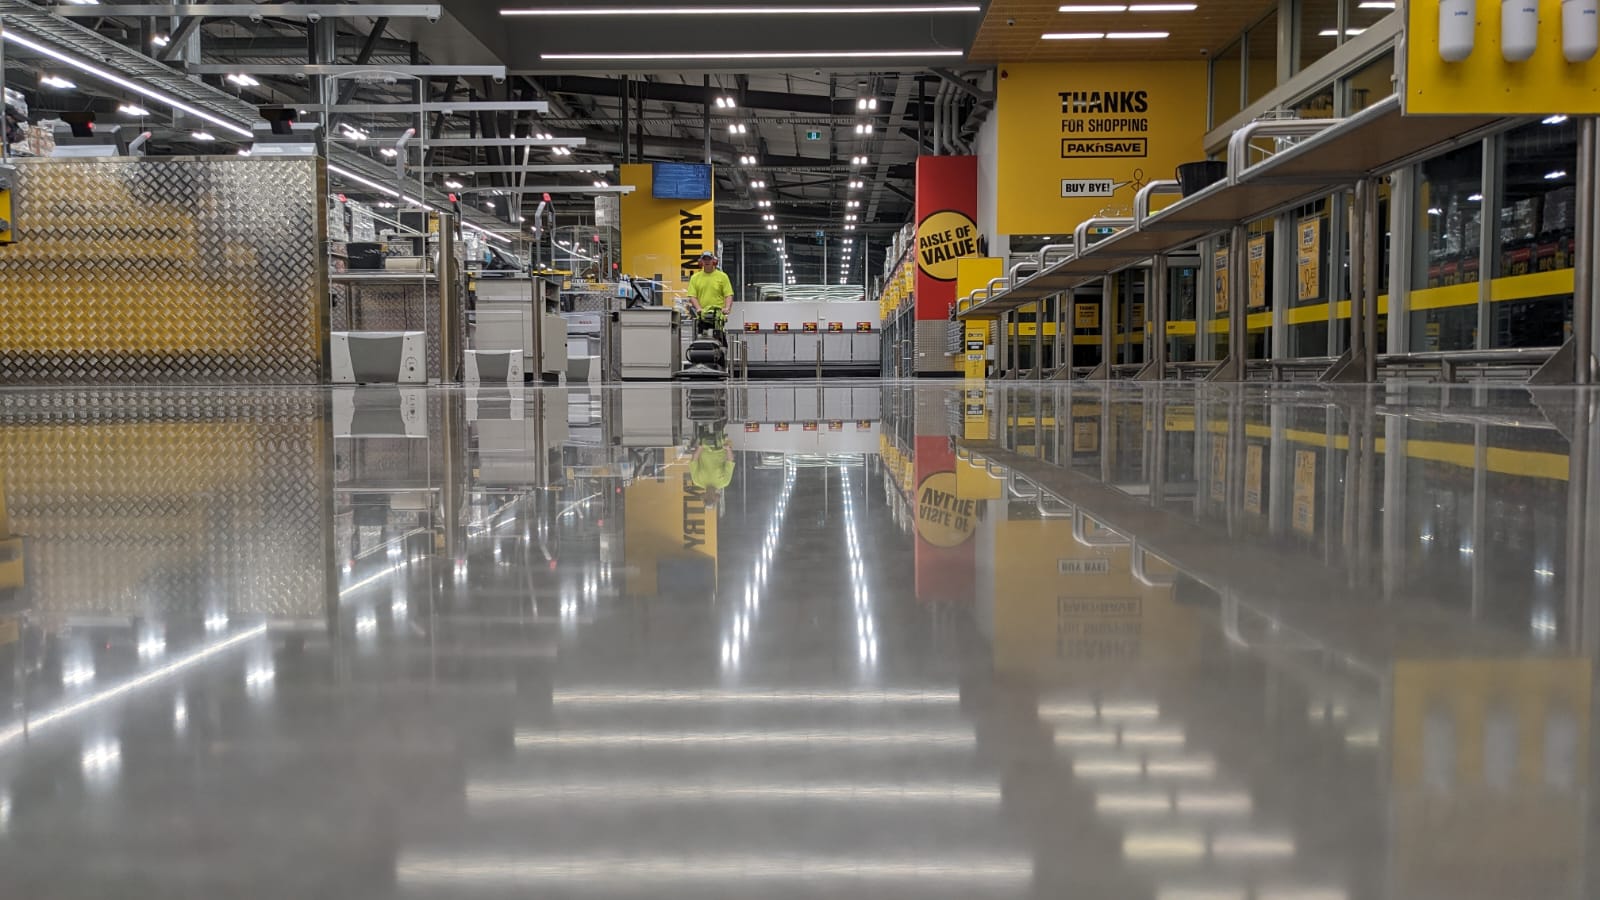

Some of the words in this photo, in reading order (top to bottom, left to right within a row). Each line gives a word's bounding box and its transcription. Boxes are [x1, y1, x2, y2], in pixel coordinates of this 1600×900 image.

[1058, 91, 1148, 114] THANKS
[1061, 119, 1084, 133] FOR
[1088, 118, 1148, 132] SHOPPING
[1065, 183, 1085, 193] BUY
[1088, 182, 1110, 193] BYE!
[919, 230, 953, 249] AISLE
[955, 225, 970, 239] OF
[921, 237, 976, 266] VALUE
